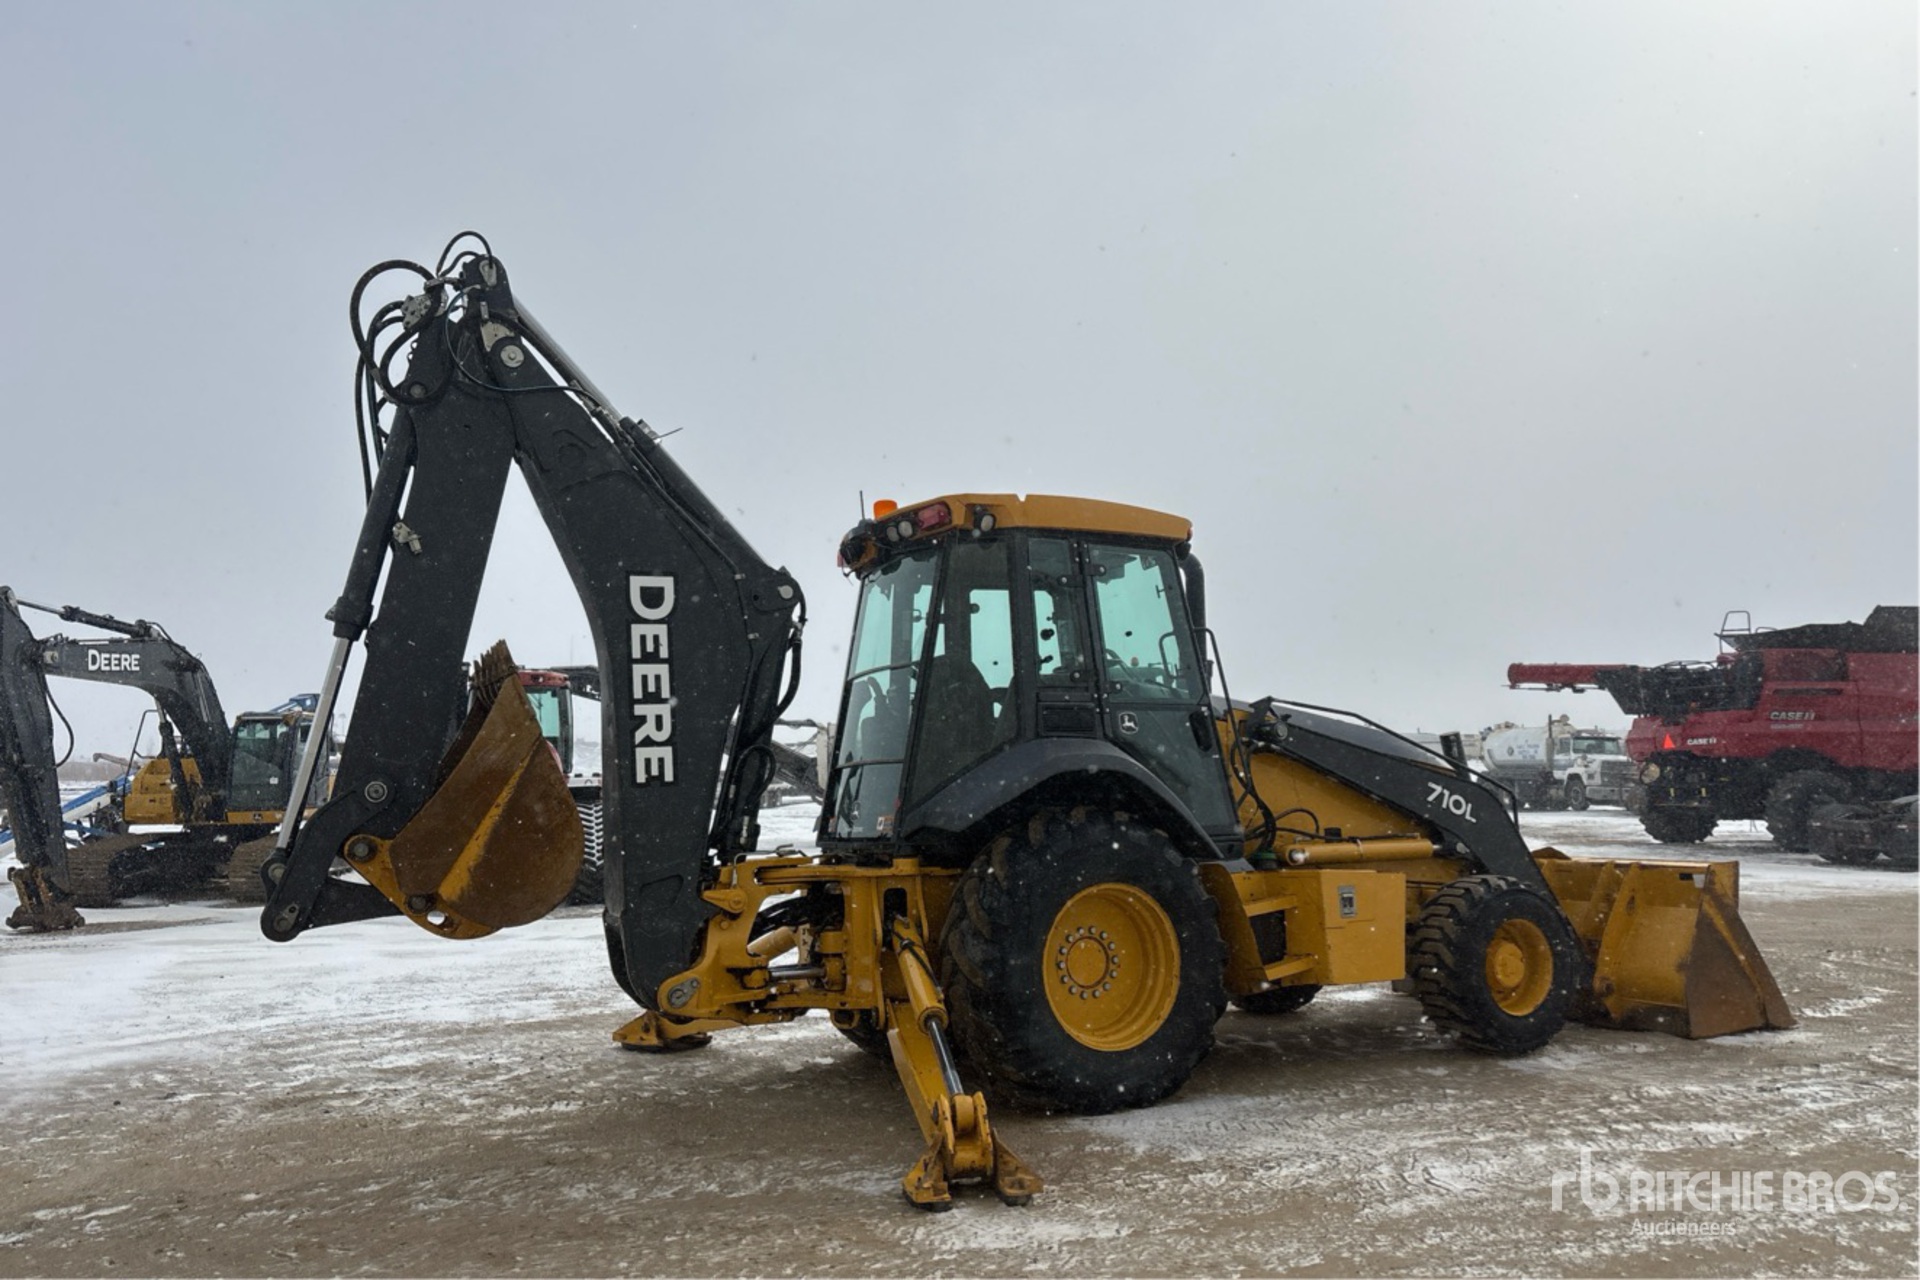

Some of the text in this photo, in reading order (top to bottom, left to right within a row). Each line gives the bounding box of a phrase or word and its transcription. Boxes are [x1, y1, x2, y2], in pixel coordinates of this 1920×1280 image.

[88, 648, 140, 671] DEERE
[629, 575, 675, 784] DEERE
[1770, 711, 1803, 720] CASE
[1426, 781, 1477, 823] 710L
